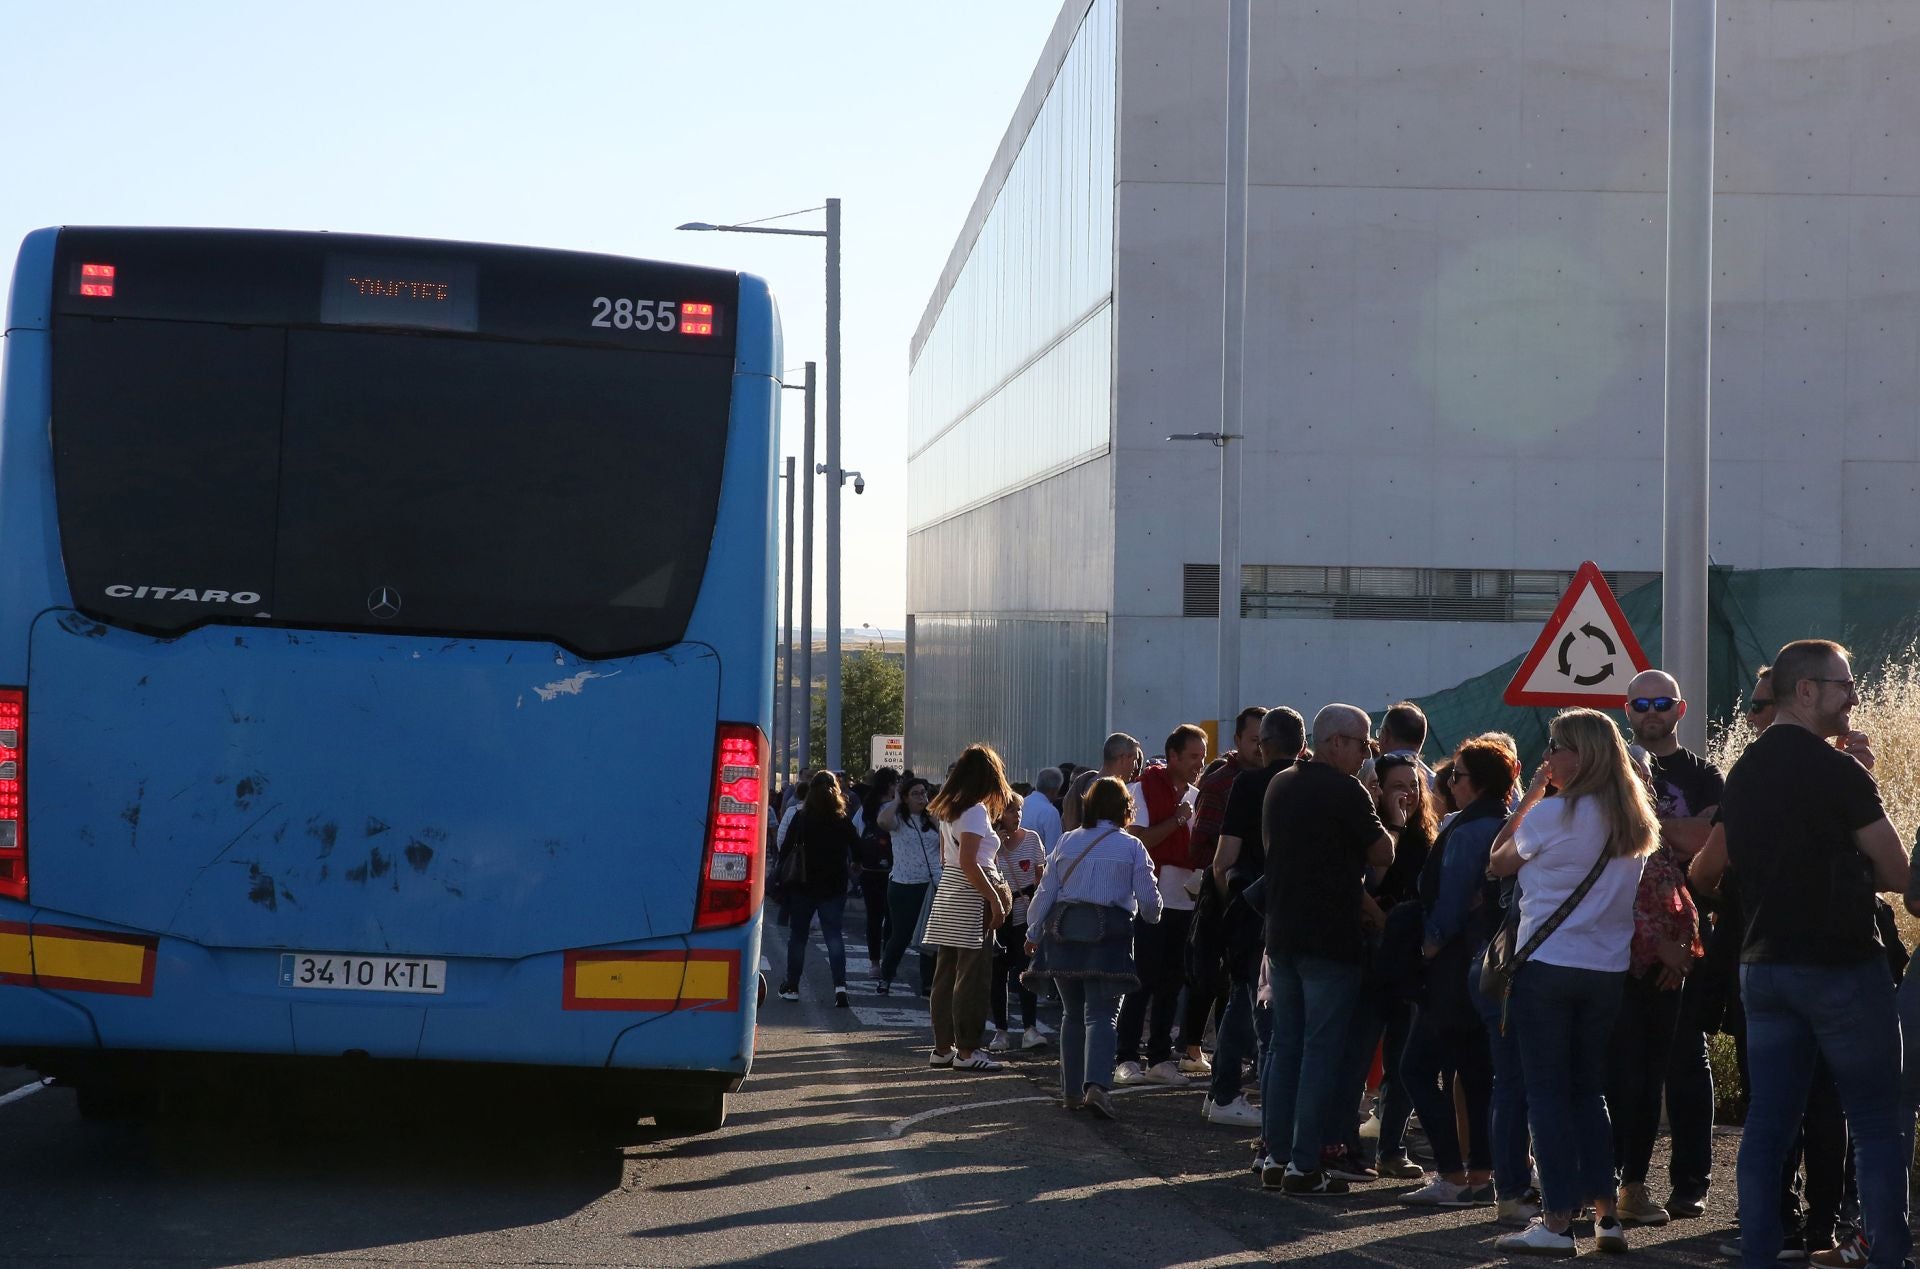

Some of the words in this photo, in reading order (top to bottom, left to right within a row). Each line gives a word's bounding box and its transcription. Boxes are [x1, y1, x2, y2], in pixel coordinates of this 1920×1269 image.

[591, 297, 676, 331] 2855
[104, 584, 261, 604] CITARO
[300, 958, 375, 985] 3410
[384, 962, 438, 989] KTL
